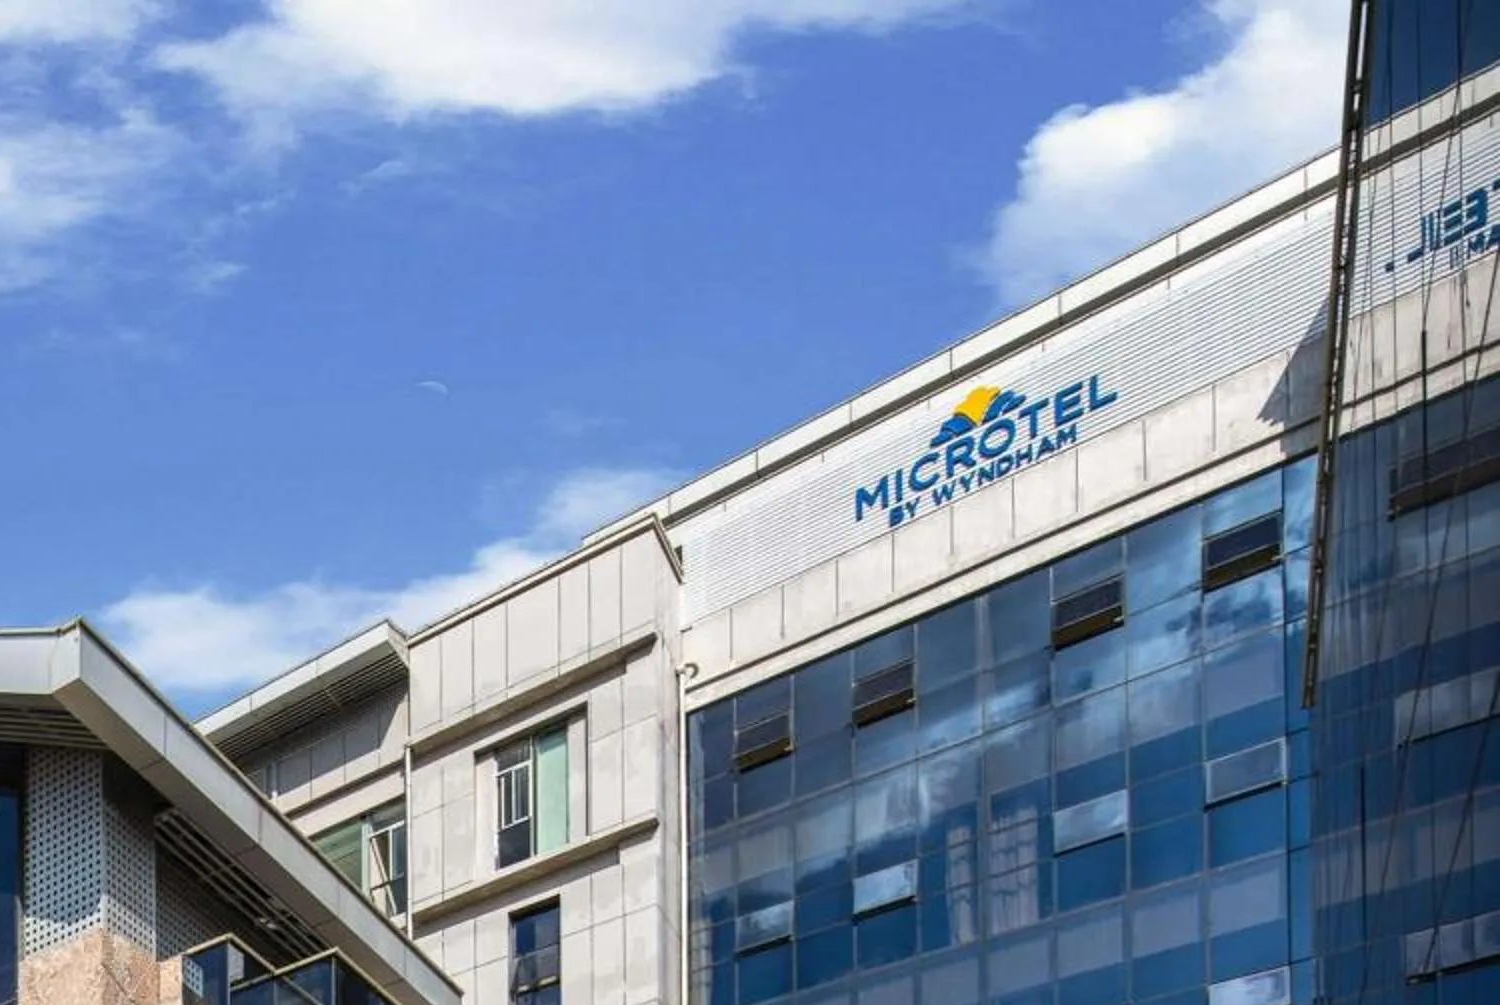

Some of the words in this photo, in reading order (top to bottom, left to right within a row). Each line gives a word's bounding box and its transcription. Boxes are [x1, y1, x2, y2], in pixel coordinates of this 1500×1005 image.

[855, 374, 1118, 521] MICROTEL
[889, 497, 921, 527] BY
[932, 424, 1078, 505] WYNDHAM
